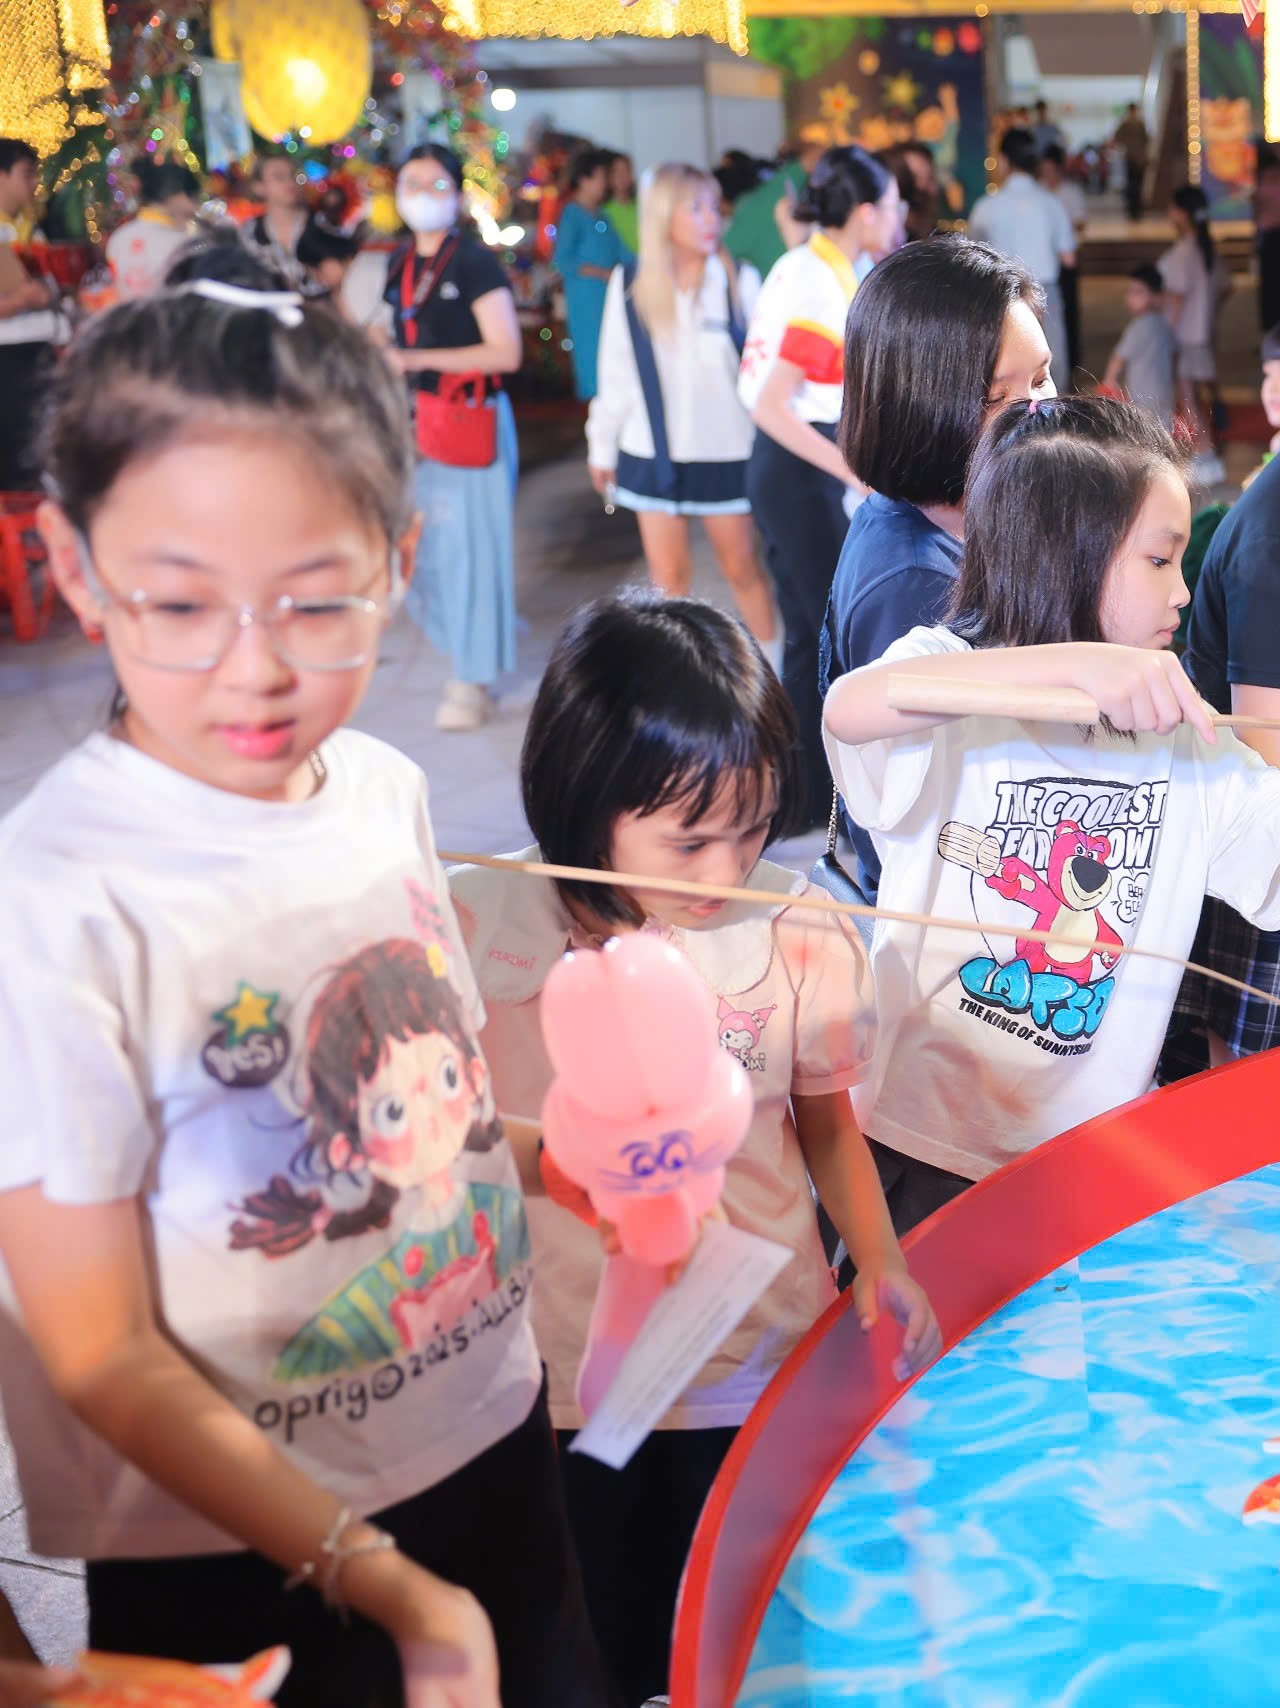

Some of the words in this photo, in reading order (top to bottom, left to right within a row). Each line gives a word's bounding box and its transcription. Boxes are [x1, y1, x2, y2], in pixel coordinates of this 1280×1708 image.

[993, 781, 1047, 826] THE
[1041, 781, 1169, 830] COOLEST
[958, 998, 986, 1018] THE
[982, 1009, 1020, 1034] KING
[1016, 1026, 1037, 1041] OF
